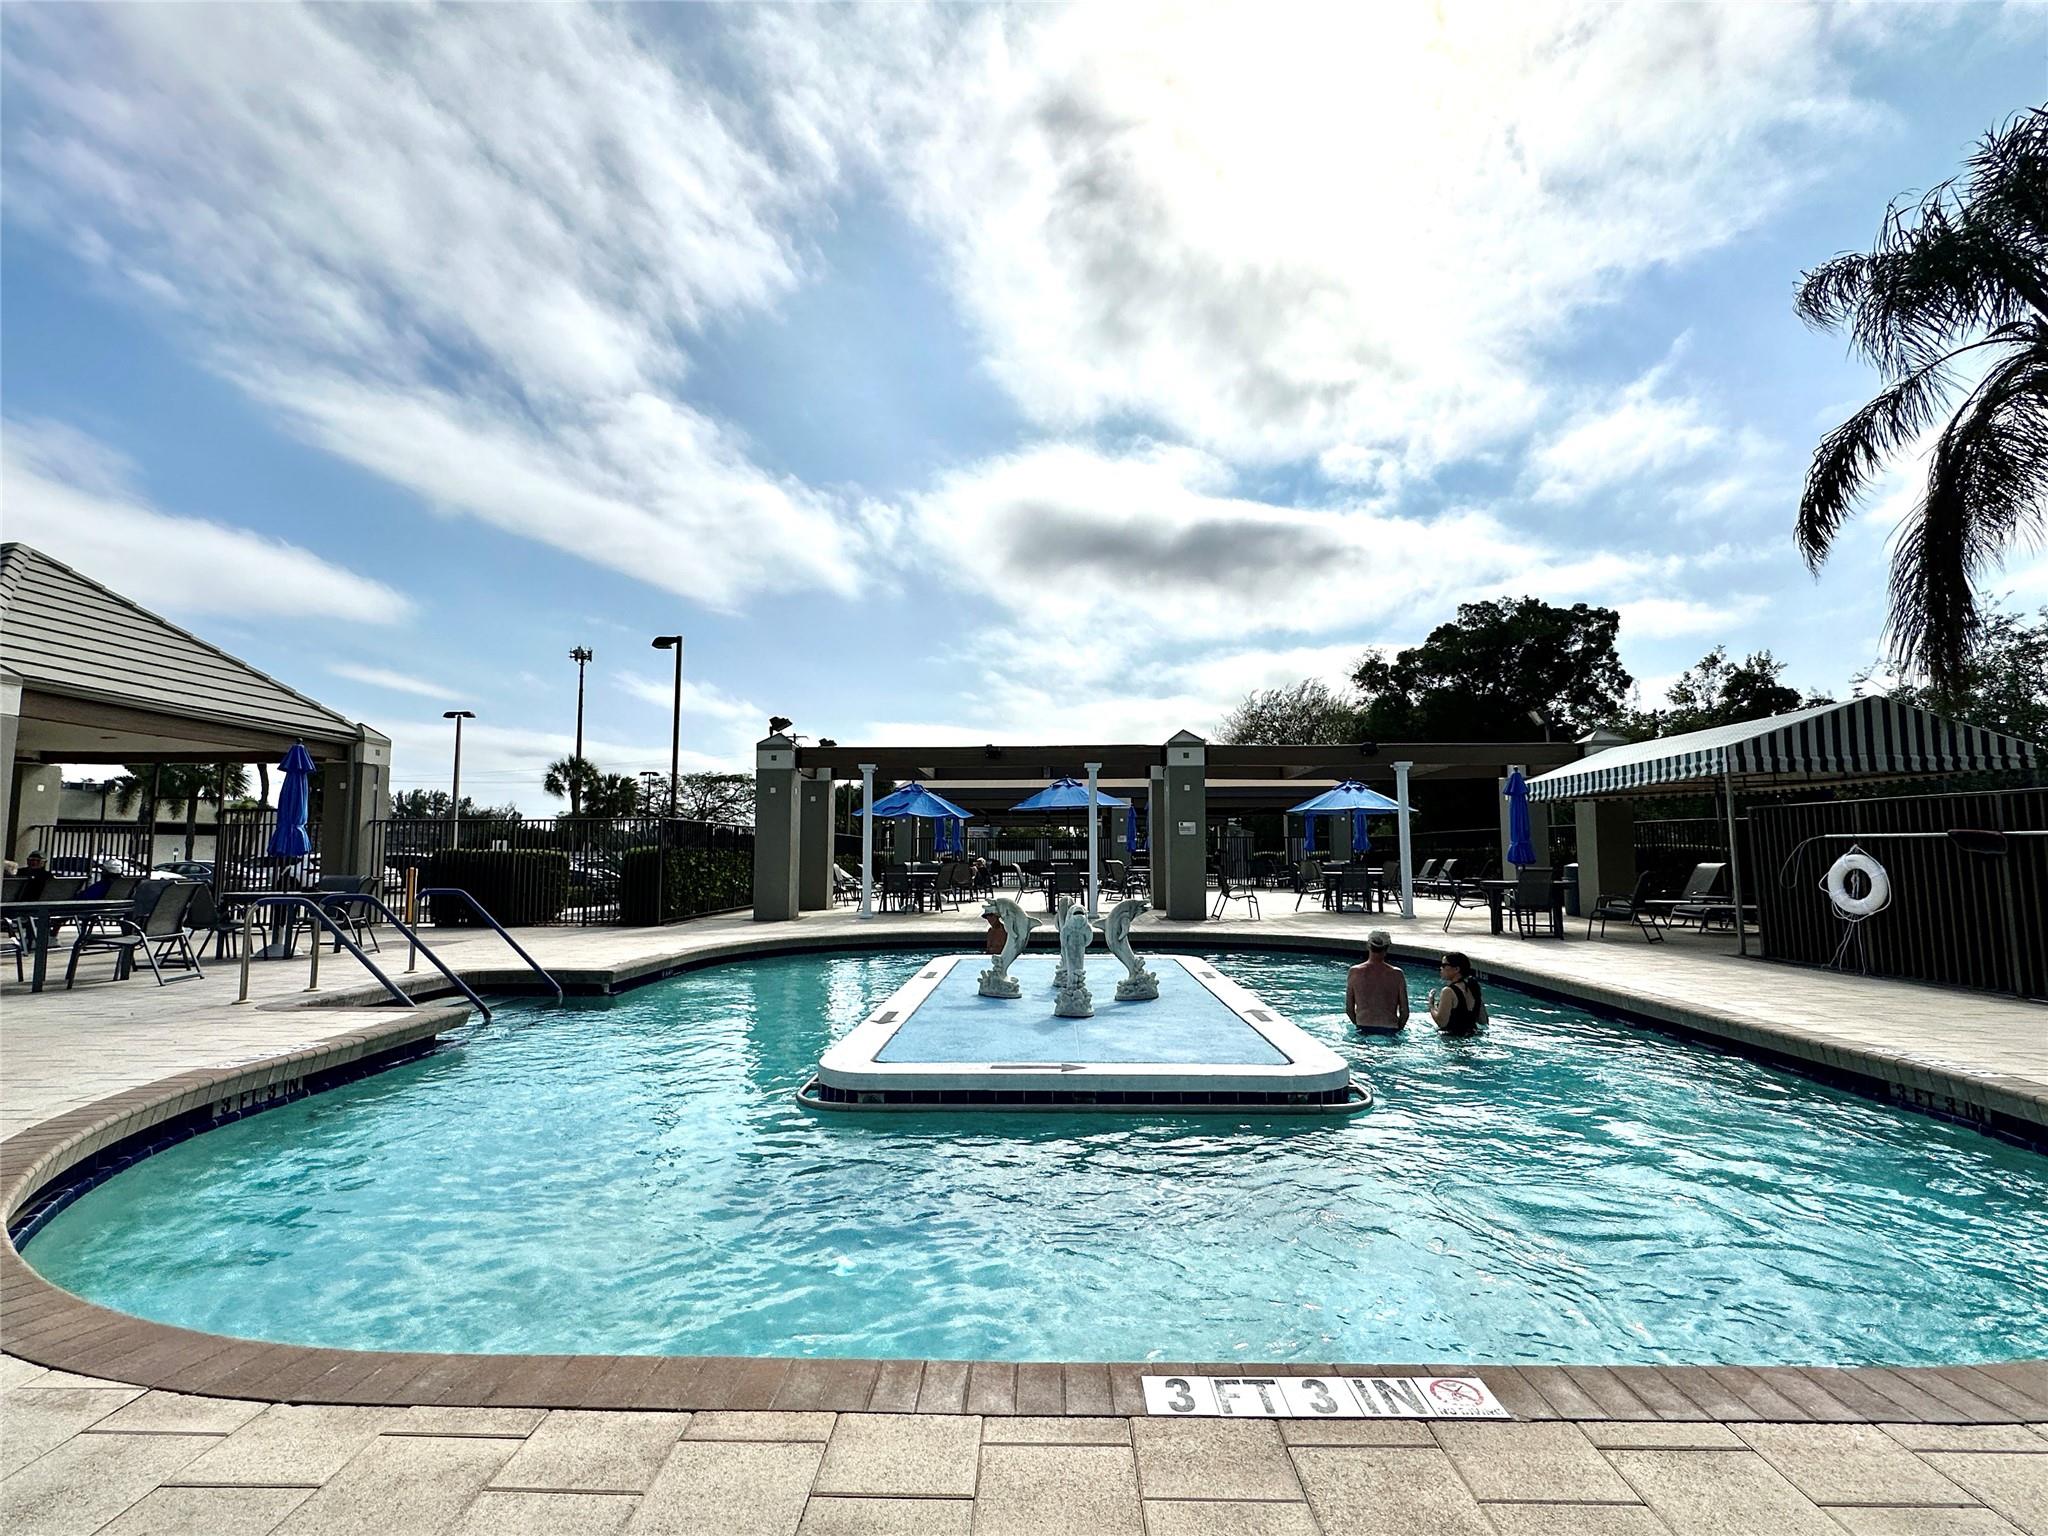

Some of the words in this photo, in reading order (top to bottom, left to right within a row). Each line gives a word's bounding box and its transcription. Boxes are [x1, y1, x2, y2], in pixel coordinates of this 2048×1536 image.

[221, 1097, 231, 1113] 3
[267, 1083, 277, 1099] 3
[283, 1078, 300, 1096] IN
[1896, 1084, 1906, 1102] 3
[1914, 1088, 1935, 1108] FT
[1944, 1096, 1956, 1114] 3
[1964, 1101, 1986, 1121] IN
[1165, 1378, 1196, 1412] 3
[1213, 1379, 1275, 1414] FT
[1301, 1378, 1339, 1414] 3
[1352, 1379, 1428, 1414] IN
